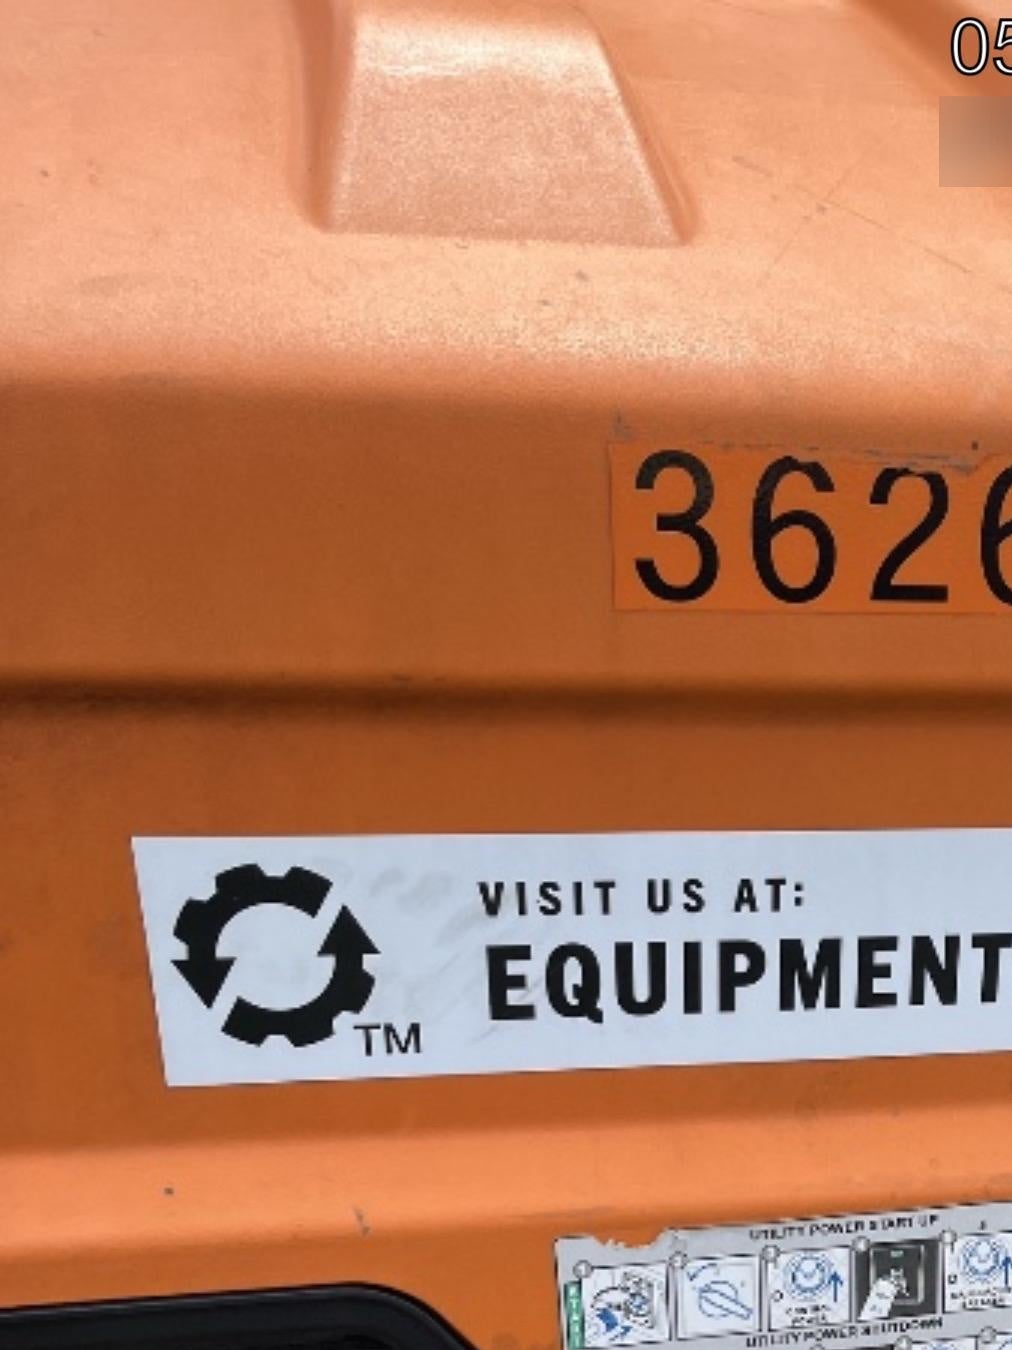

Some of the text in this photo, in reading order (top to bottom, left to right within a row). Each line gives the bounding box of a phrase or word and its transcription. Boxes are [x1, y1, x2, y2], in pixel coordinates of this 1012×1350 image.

[477, 877, 805, 917] VISIT US AT:
[353, 1022, 423, 1057] TM
[809, 1220, 865, 1236] POWER
